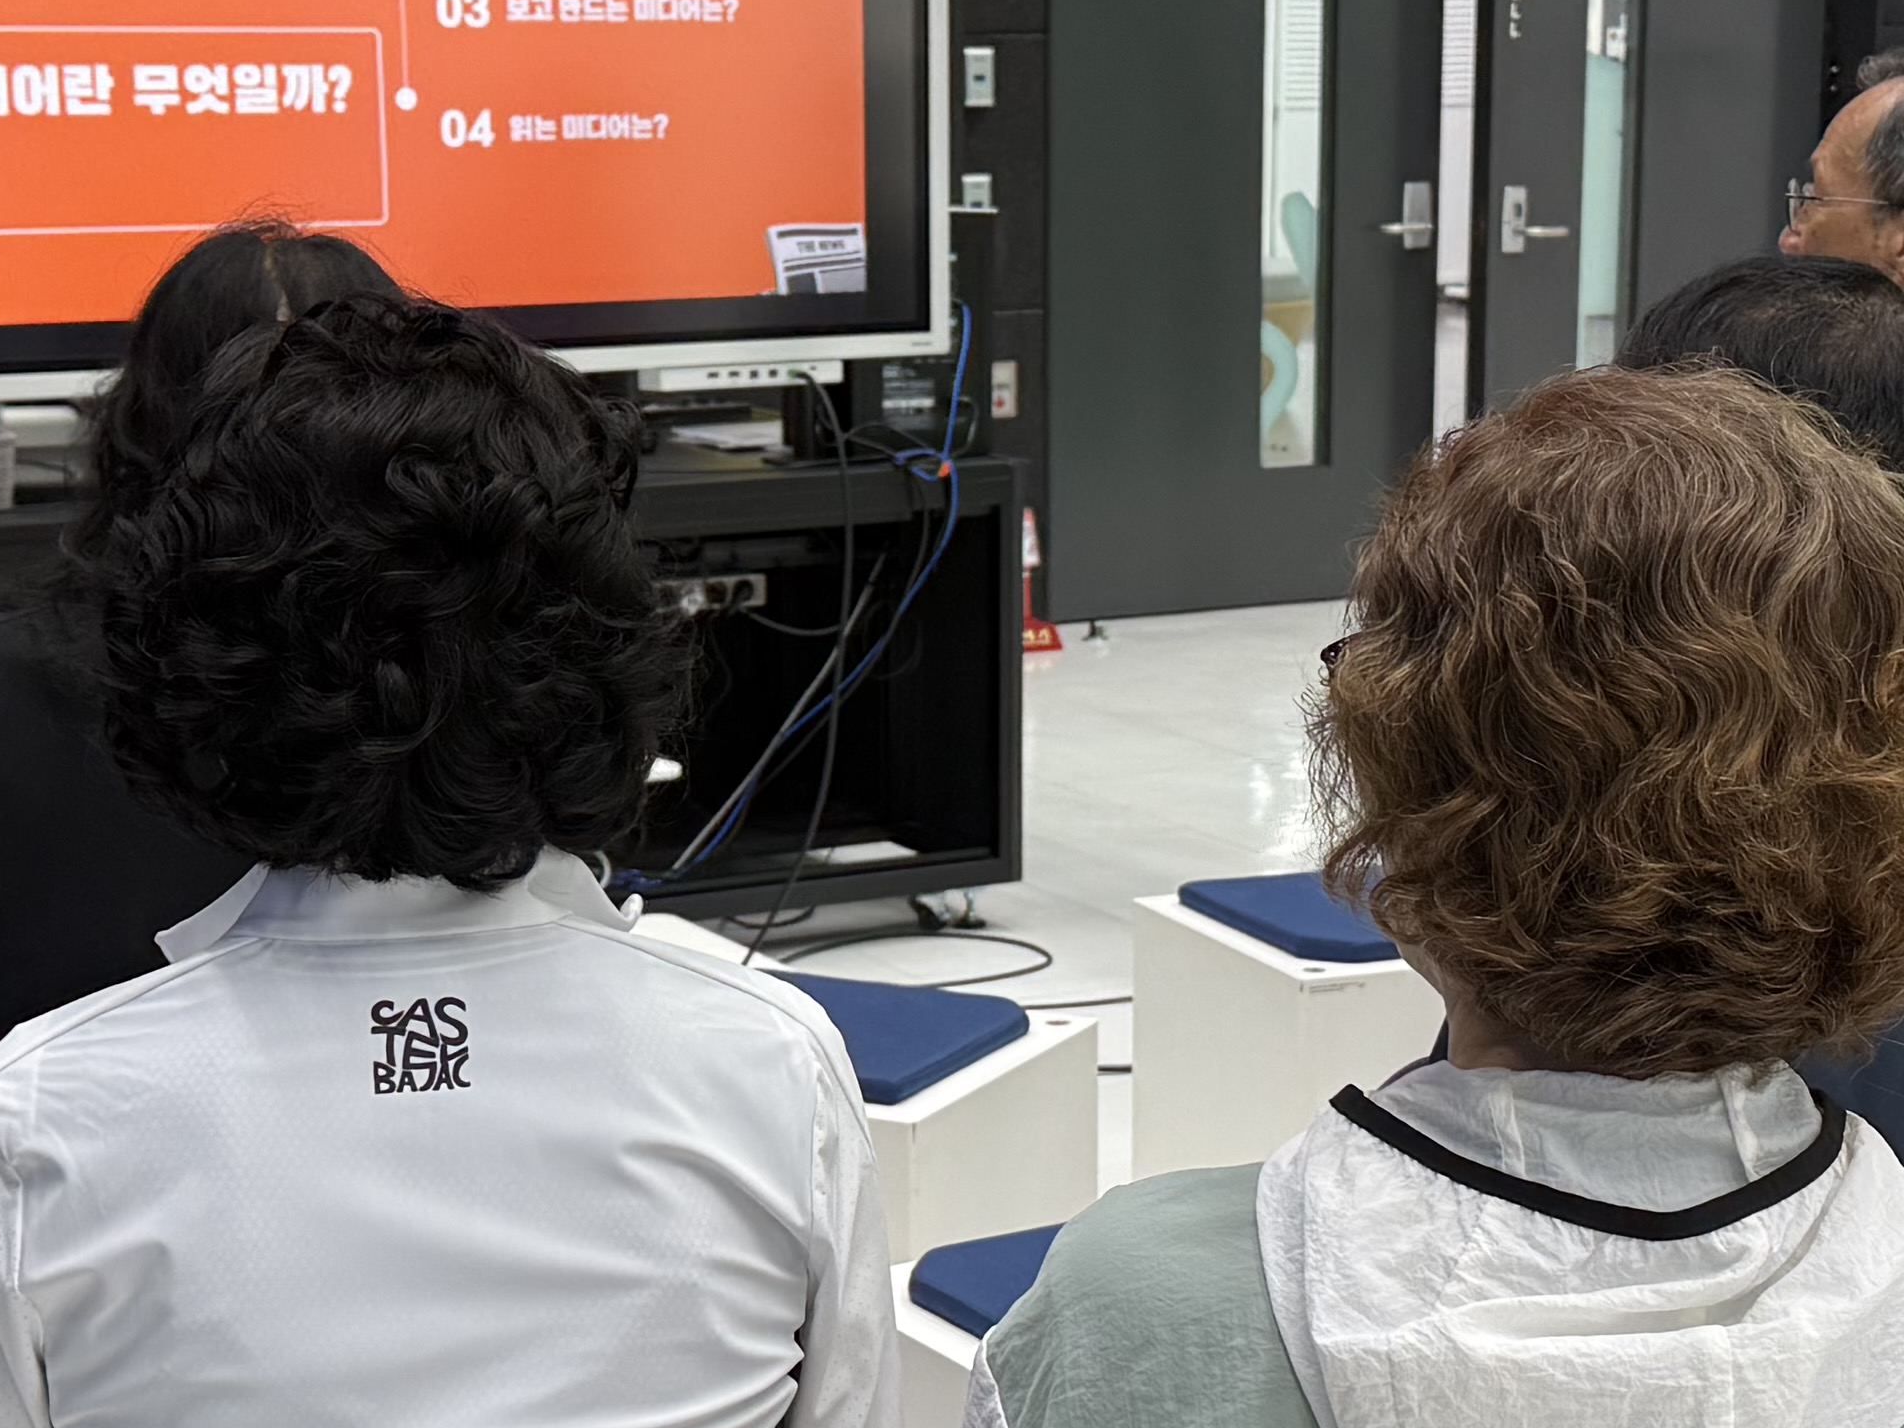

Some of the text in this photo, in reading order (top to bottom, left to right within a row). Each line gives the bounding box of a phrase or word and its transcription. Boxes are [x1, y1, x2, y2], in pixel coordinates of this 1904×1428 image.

[132, 63, 353, 116] 무엇일까?
[441, 109, 495, 148] 04
[562, 113, 669, 140] 미디어는?
